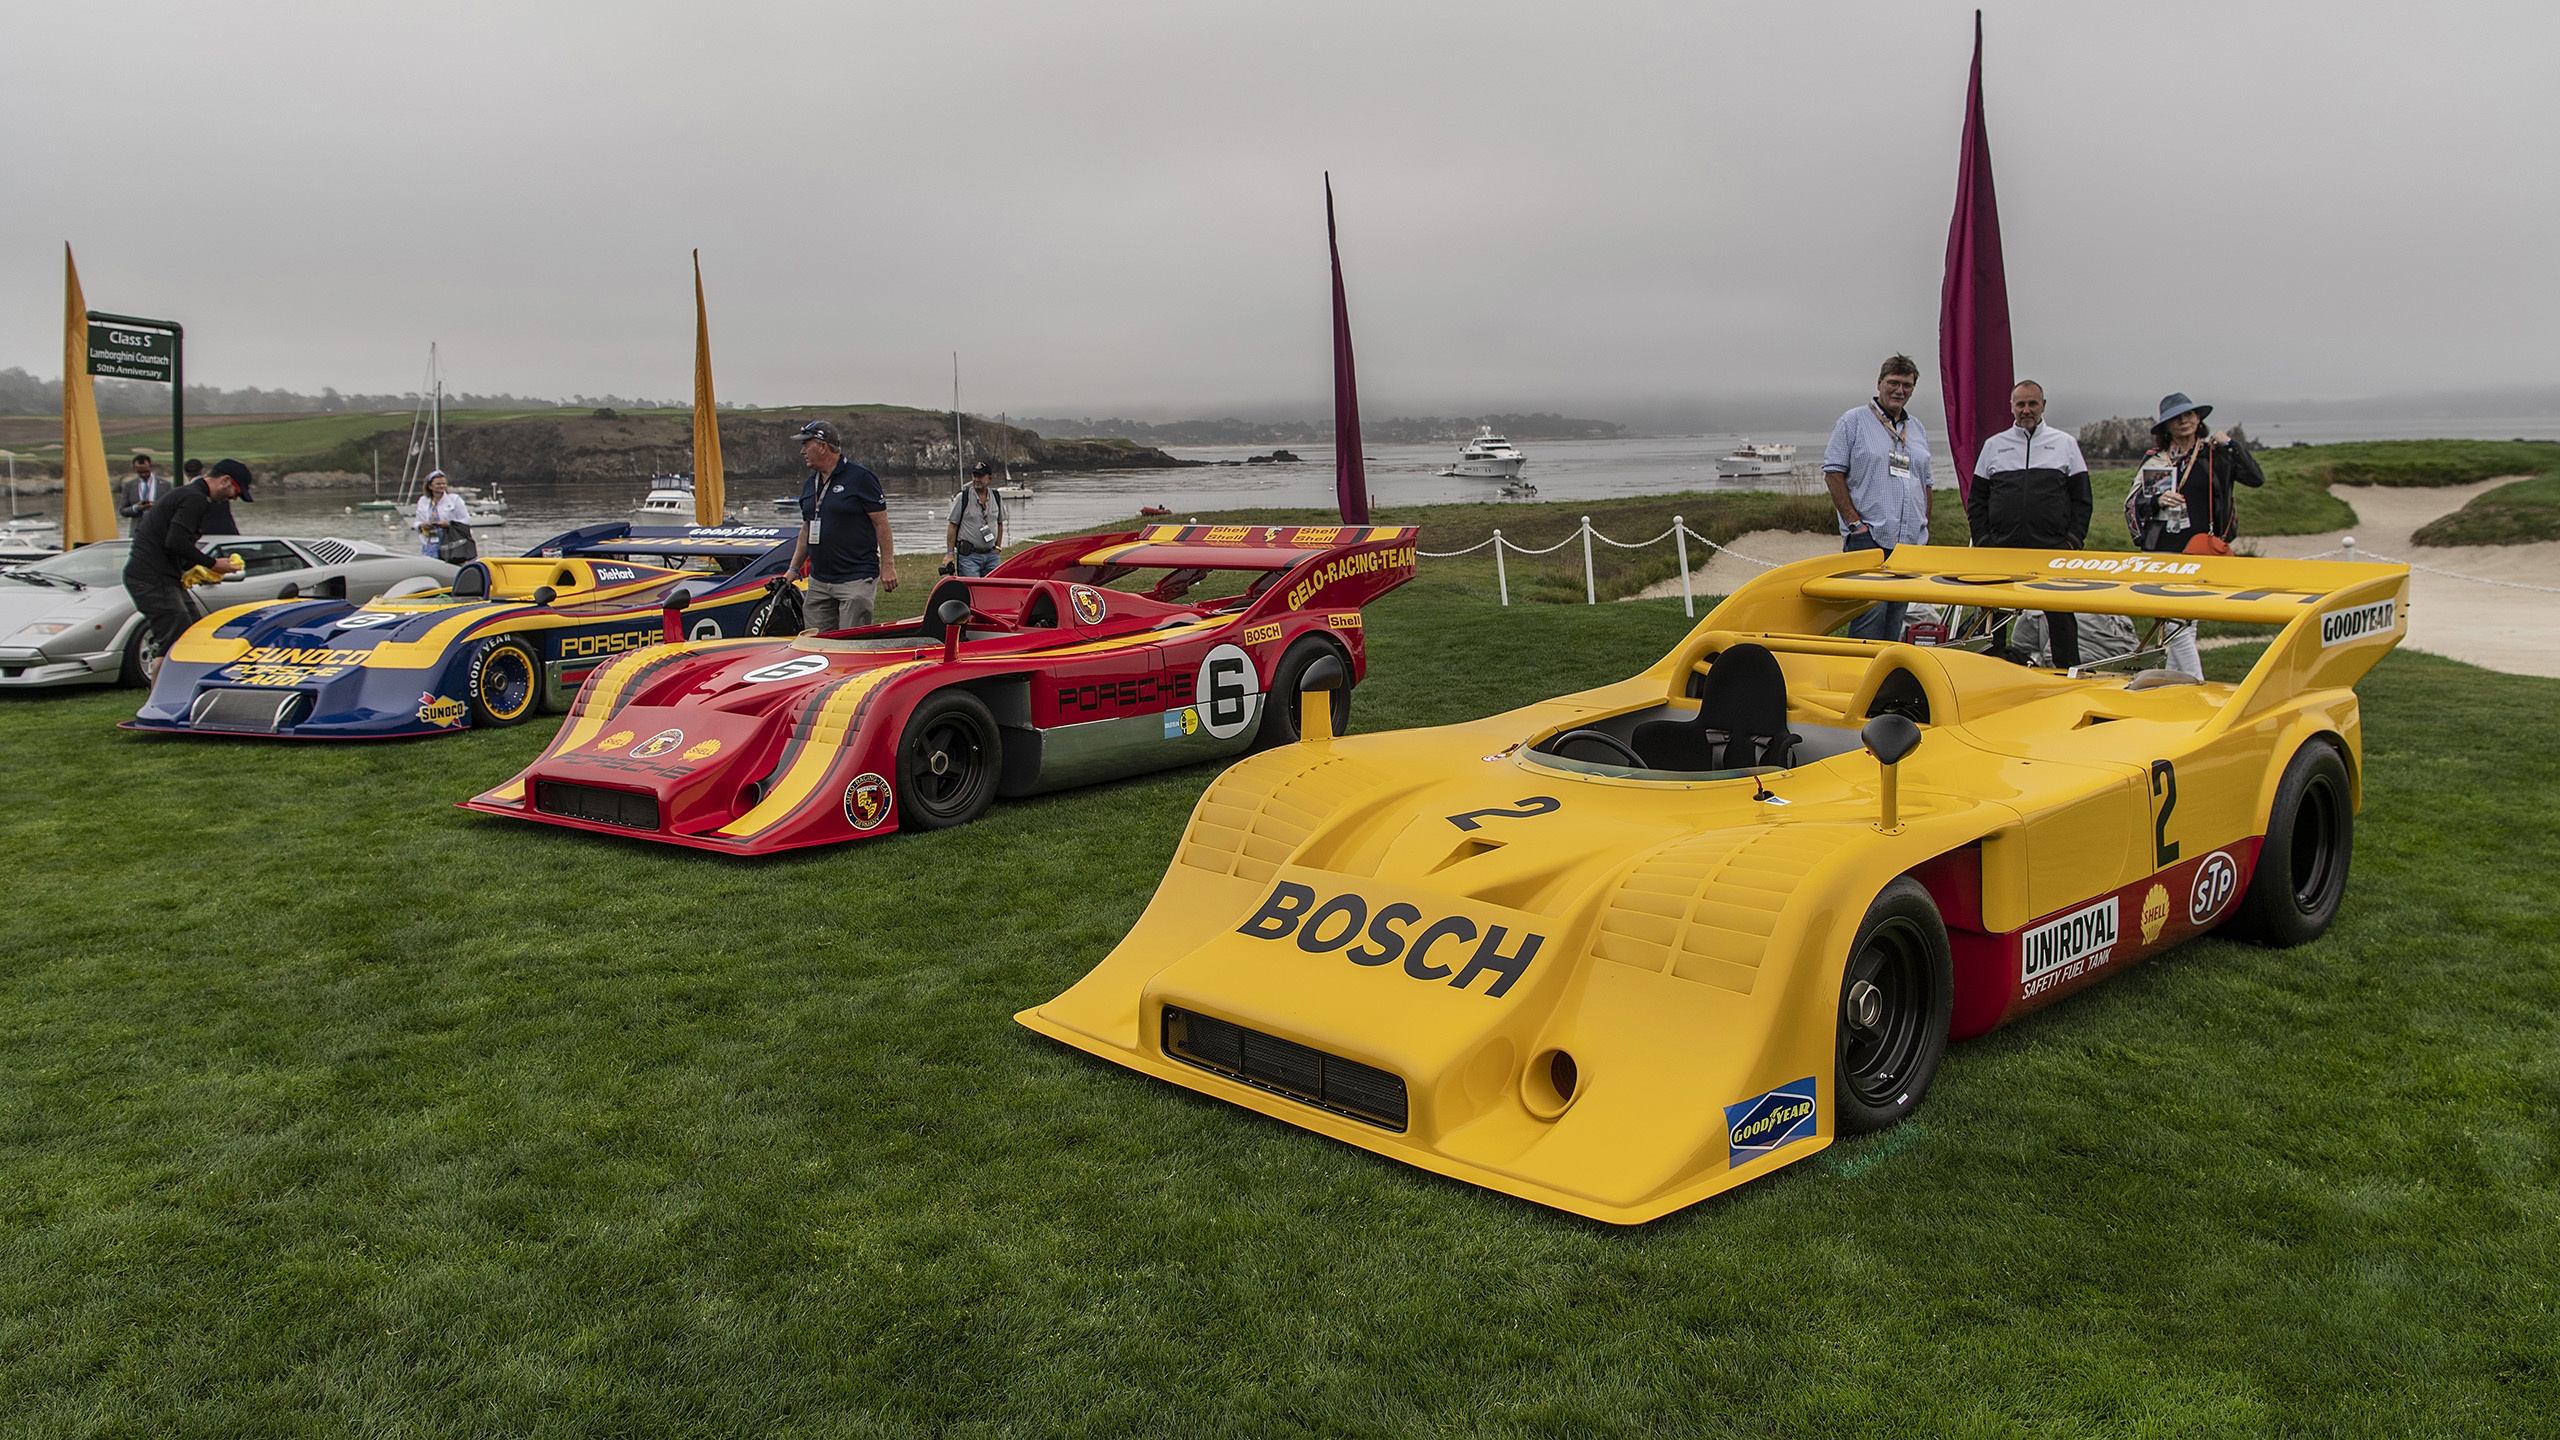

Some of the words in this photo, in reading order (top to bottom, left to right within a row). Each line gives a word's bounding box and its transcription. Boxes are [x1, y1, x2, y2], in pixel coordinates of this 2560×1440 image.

[109, 331, 141, 347] Class
[143, 335, 152, 347] S
[89, 347, 135, 363] Lamborghini
[136, 352, 169, 365] Countach
[96, 363, 115, 373] 50th
[116, 365, 162, 379] Anniversary
[596, 566, 635, 581] DieHard
[1246, 625, 1280, 643] BOSCH
[1331, 615, 1361, 626] Shell
[2323, 602, 2393, 642] GOODYEAR
[238, 647, 373, 666] SUNOCO
[225, 664, 343, 677] PORSCHE
[1059, 673, 1192, 714] PORSCHE
[1209, 657, 1245, 727] 6
[422, 703, 463, 720] SUNOCO
[557, 753, 697, 780] PORSCHE
[1445, 796, 1561, 832] 2
[2151, 759, 2180, 868] 2
[2193, 859, 2232, 915] STP
[2144, 905, 2166, 925] SHELL
[1236, 880, 1546, 999] BOSCH
[2026, 904, 2116, 975] UNIROYAL
[2022, 969, 2062, 1000] SAFETY
[2061, 959, 2085, 983] FUEL
[2087, 948, 2113, 970] TANK
[1734, 1101, 1811, 1143] GOODYEAR
